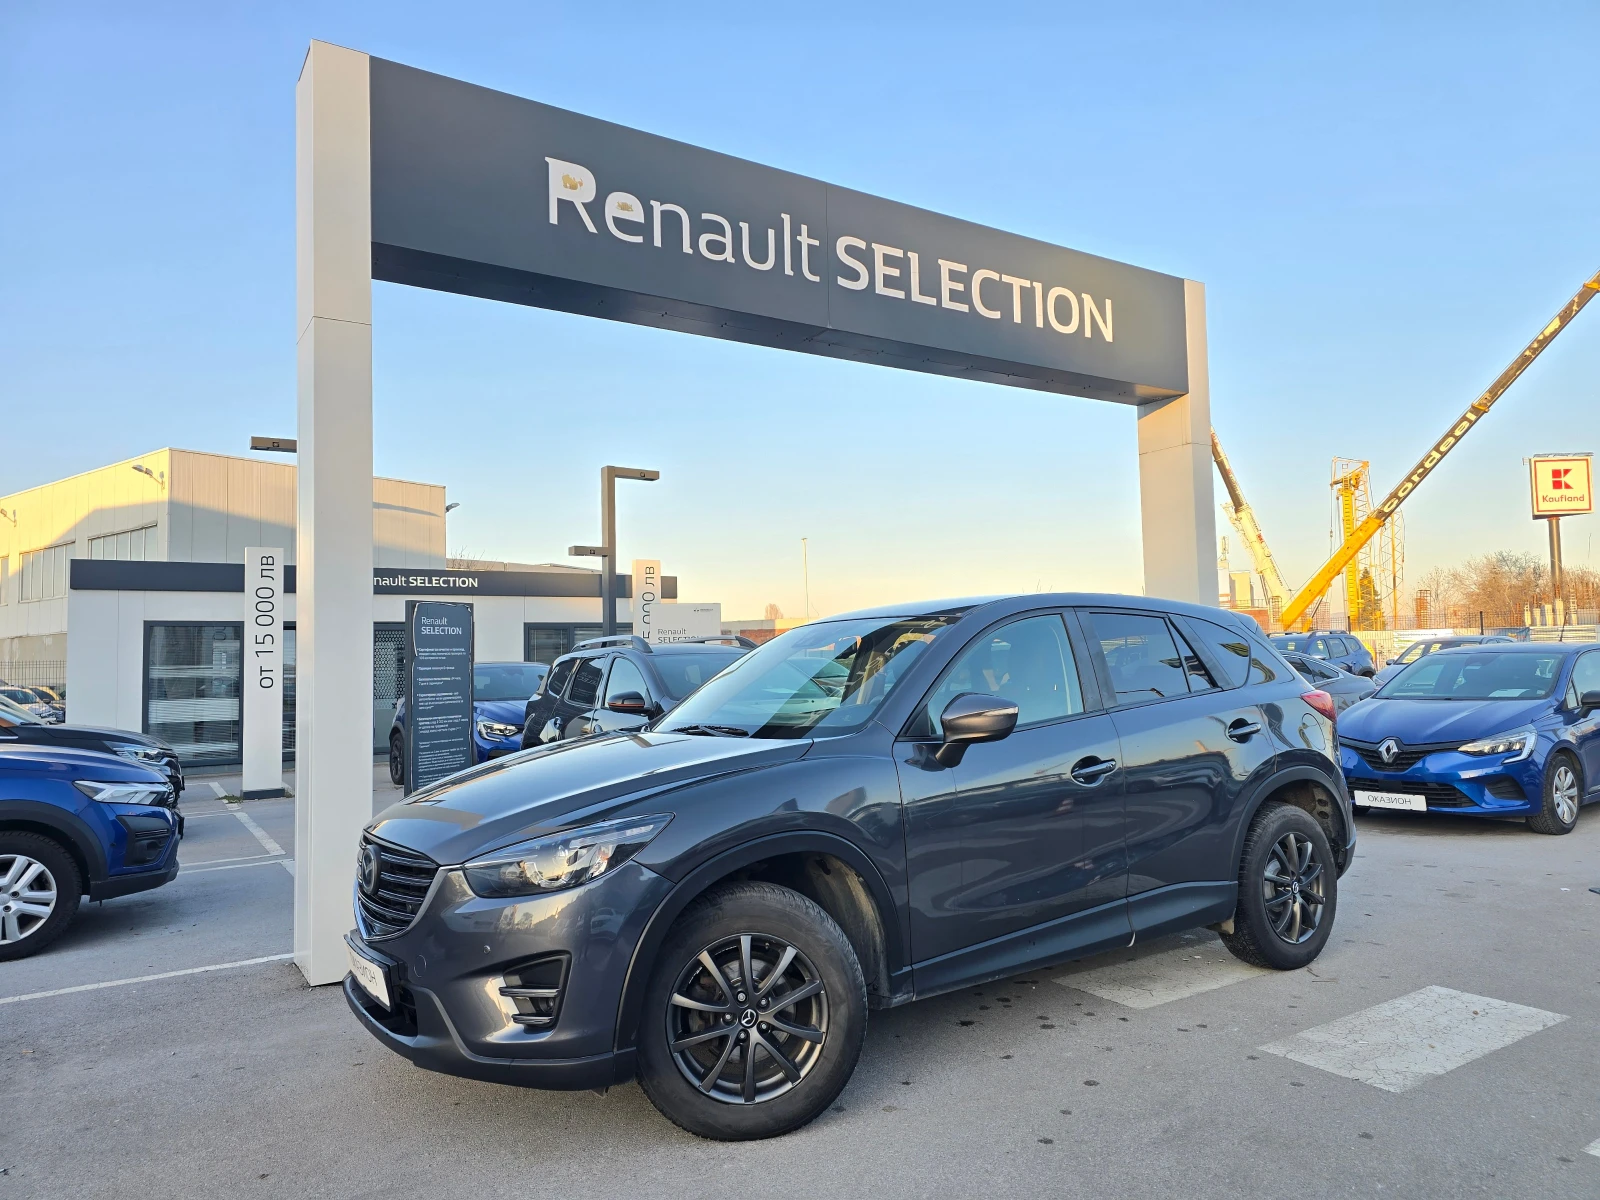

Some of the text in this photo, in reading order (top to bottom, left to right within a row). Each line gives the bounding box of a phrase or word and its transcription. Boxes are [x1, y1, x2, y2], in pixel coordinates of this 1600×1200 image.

[545, 157, 1113, 343] Renault SELECTION
[1383, 411, 1477, 513] cordeel
[1542, 494, 1585, 503] Kaufland
[374, 575, 478, 588] nault SELECTION
[255, 586, 275, 627] 000
[421, 616, 448, 626] Renault
[421, 626, 462, 635] SELECTION
[657, 628, 687, 636] Renault
[255, 633, 274, 658] 15
[1367, 794, 1412, 806] ОКАЗИОН
